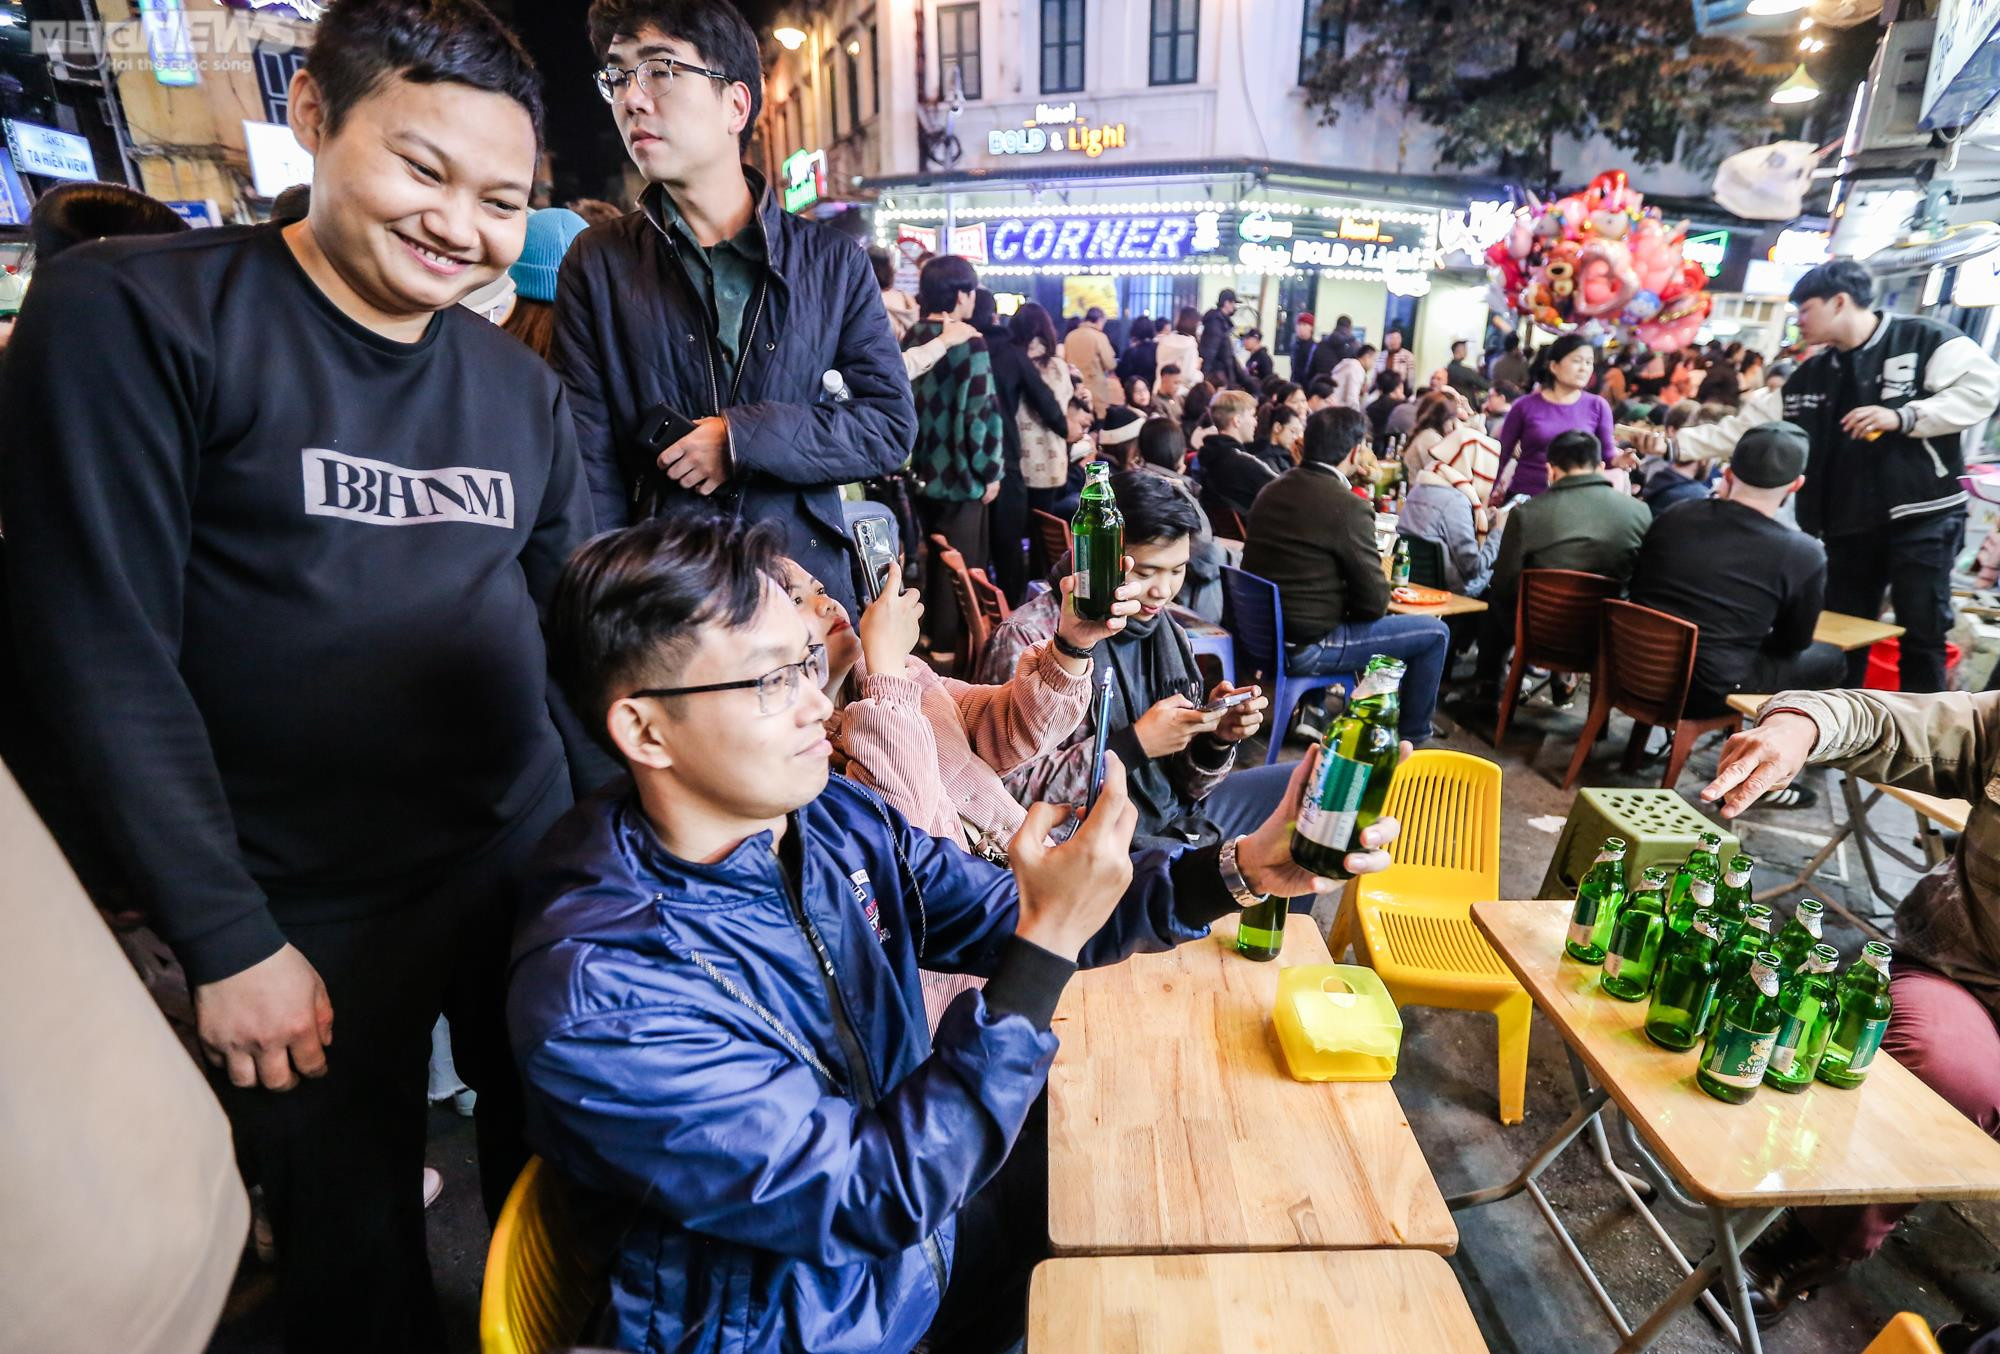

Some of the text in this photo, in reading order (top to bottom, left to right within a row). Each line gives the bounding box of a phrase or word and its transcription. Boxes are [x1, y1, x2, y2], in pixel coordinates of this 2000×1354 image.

[989, 129, 1047, 155] BOLD
[1068, 123, 1126, 158] Light
[993, 218, 1189, 261] CORNER
[1293, 239, 1349, 267] BOLD
